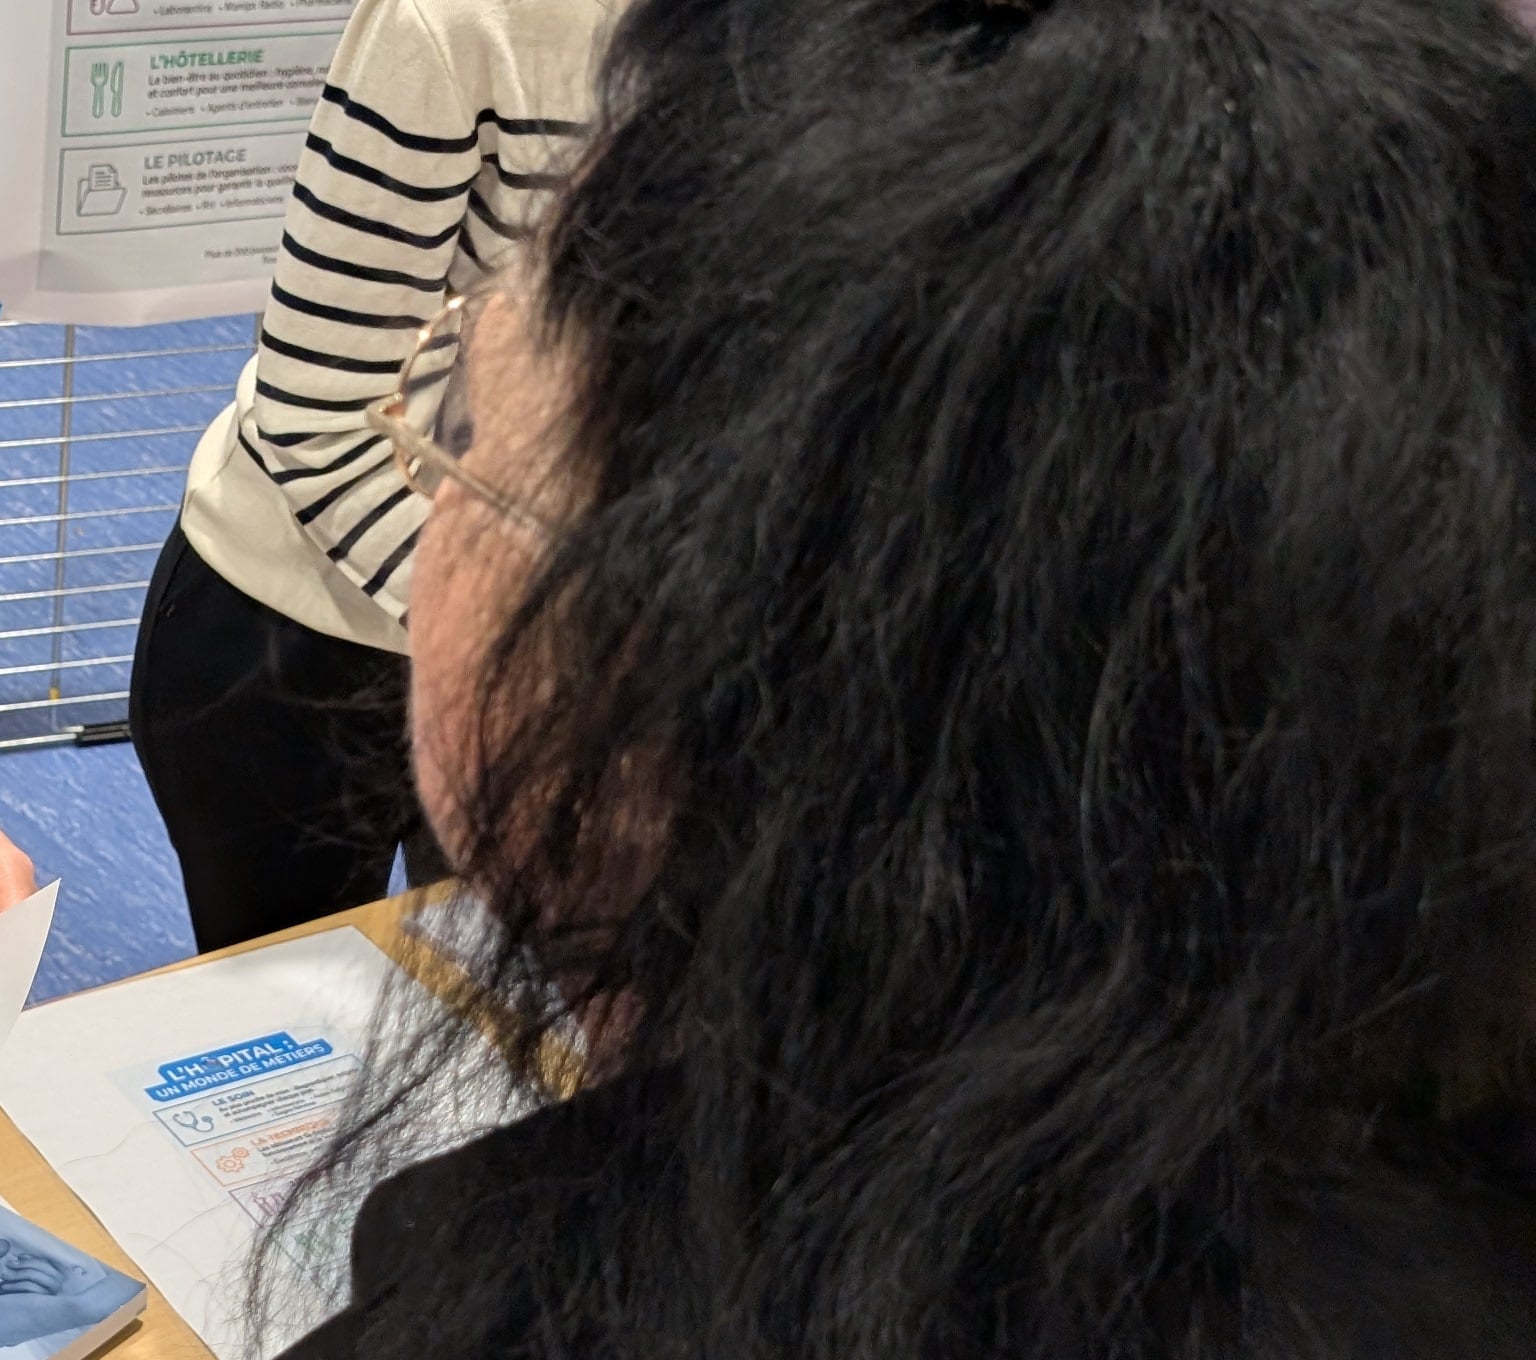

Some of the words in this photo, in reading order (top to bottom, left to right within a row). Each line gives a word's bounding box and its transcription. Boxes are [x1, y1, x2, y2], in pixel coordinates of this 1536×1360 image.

[144, 155, 163, 170] LE
[167, 149, 247, 168] PILOTAGE
[156, 1085, 179, 1097] UN
[181, 1068, 238, 1092] MONDE
[240, 1062, 263, 1075] DE
[265, 1043, 326, 1068] MÉTIERS
